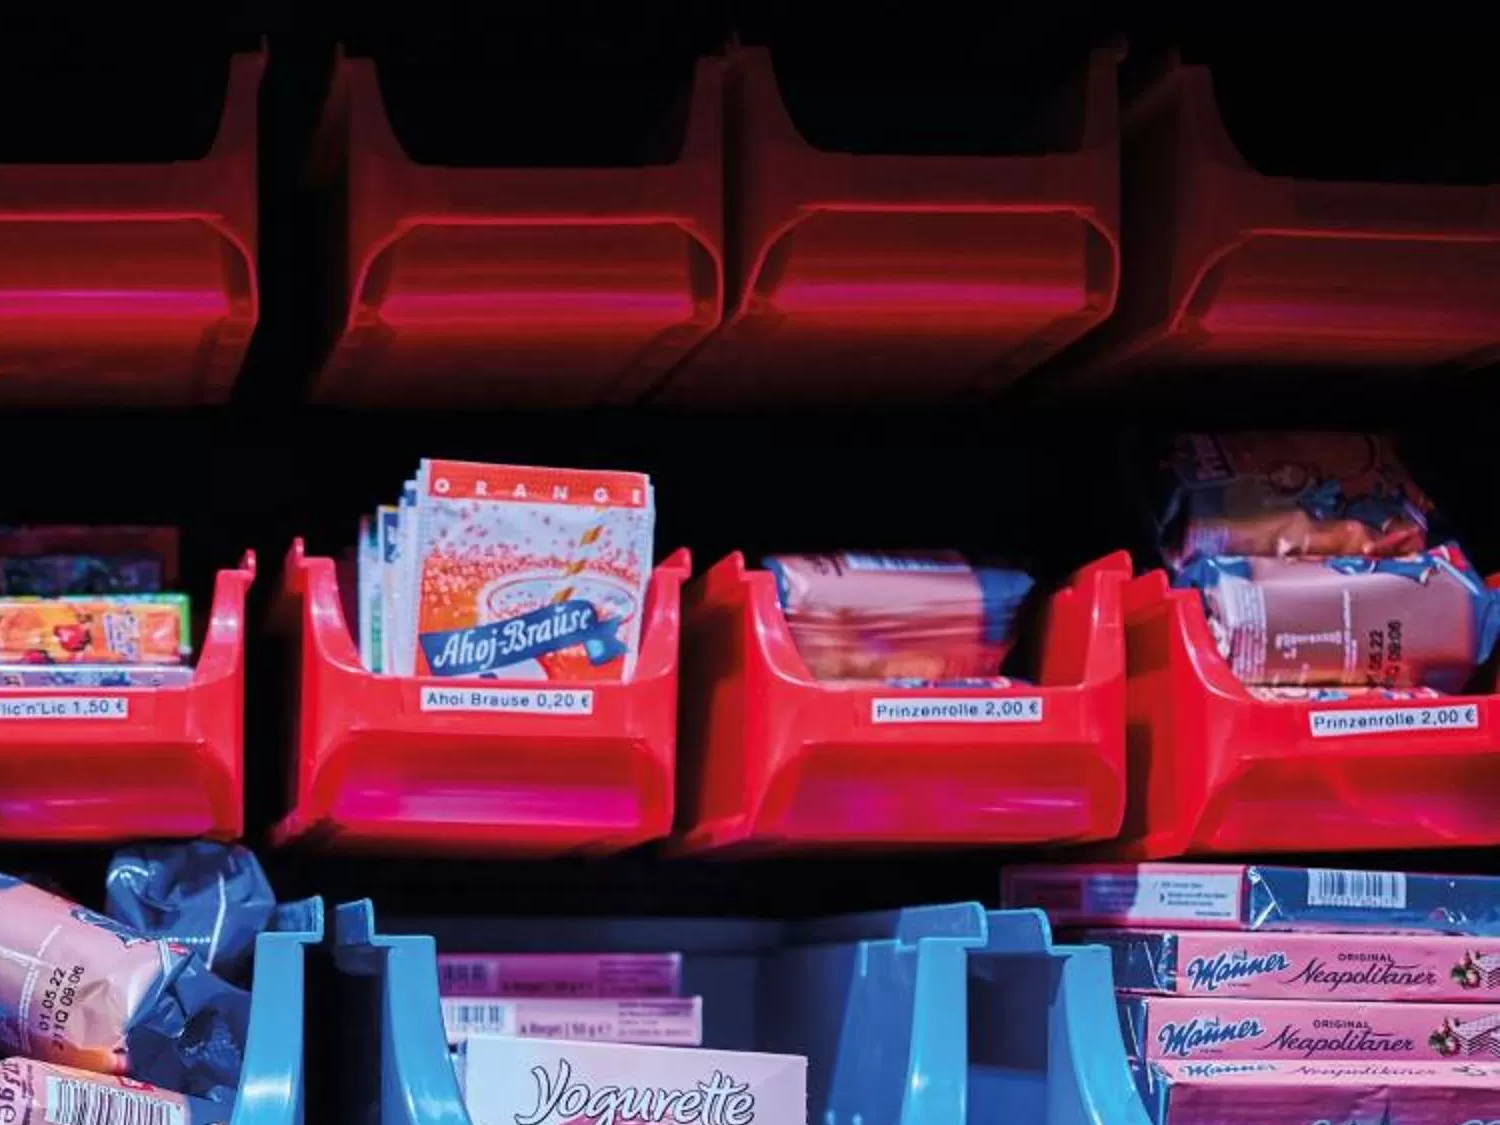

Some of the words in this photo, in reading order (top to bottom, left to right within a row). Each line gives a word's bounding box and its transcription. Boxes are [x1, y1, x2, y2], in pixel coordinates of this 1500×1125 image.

[434, 477, 643, 505] ORANGE
[433, 606, 592, 671] Ahoj-Brause
[73, 700, 109, 716] 1,50
[116, 699, 125, 713] €
[427, 692, 464, 706] Ahoi
[470, 692, 530, 707] Brause
[536, 693, 575, 709] 0,20
[581, 693, 590, 708] €
[876, 702, 978, 718] Prinzenrolle
[985, 701, 1023, 717] 2,00
[1029, 701, 1038, 714] €
[1313, 712, 1415, 729] Prinzenrolle
[1421, 710, 1459, 726] 2,00
[1465, 708, 1476, 722] €
[1337, 953, 1393, 962] ORIGINAL
[1187, 951, 1290, 991] Manner
[1278, 958, 1438, 992] Neapolitaner
[1312, 1020, 1369, 1029] ORIGINAL
[1157, 1018, 1265, 1056] Manner
[1253, 1025, 1414, 1057] Neapolitaner
